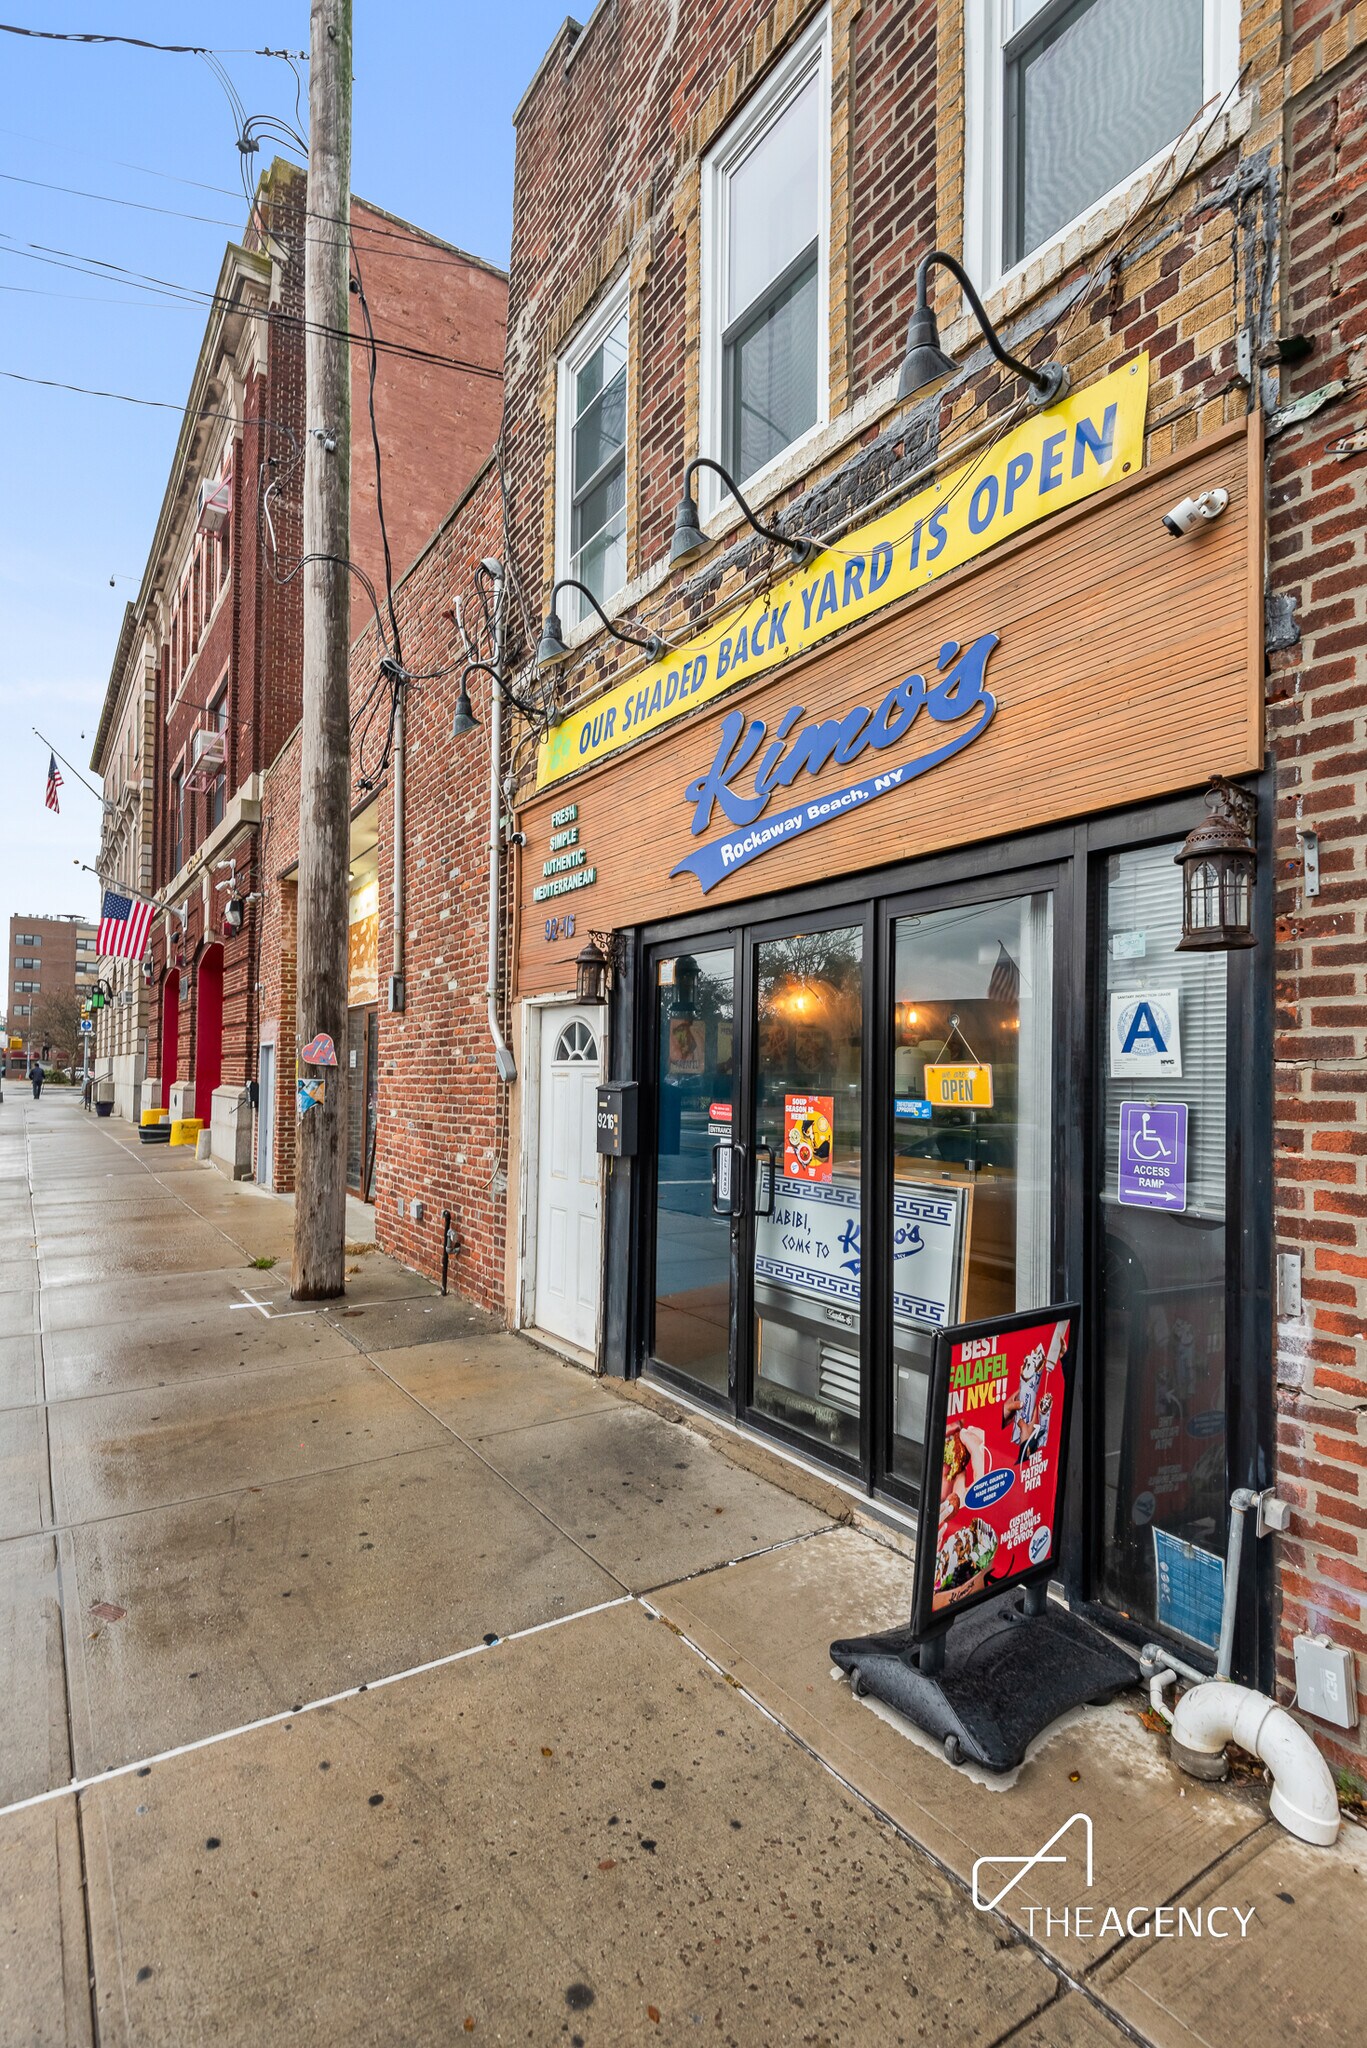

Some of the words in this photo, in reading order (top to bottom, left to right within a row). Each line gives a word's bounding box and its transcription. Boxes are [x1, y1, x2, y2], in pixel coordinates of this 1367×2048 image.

[579, 707, 616, 754] OUR
[622, 654, 708, 732] SHADED
[716, 601, 791, 680] BACK
[801, 541, 893, 630] YARD
[909, 505, 948, 571] IS
[968, 402, 1117, 535] OPEN
[685, 633, 1000, 836] Kimo's
[551, 804, 578, 828] FRESH
[720, 814, 802, 867] Rockaway
[807, 789, 869, 820] Beach,
[874, 768, 903, 791] NY
[550, 828, 579, 851] SIMPLE
[542, 849, 586, 877] AUTHENTIC
[533, 867, 597, 902] MEDITERRANEAN
[544, 914, 576, 941] 92-16
[1121, 1002, 1168, 1053] A
[792, 1097, 807, 1105] SOUP
[941, 1079, 973, 1102] OPEN
[597, 1112, 614, 1130] 9216
[785, 1105, 807, 1113] SEASON
[1133, 1164, 1170, 1177] ACCESS
[1138, 1177, 1165, 1189] RAMP
[781, 1233, 811, 1255] COME
[815, 1240, 830, 1259] TO
[961, 1335, 999, 1362] BEST
[947, 1388, 965, 1417] IN
[966, 1377, 1008, 1411] NYC!!
[1029, 1449, 1043, 1467] THE
[1020, 1458, 1048, 1483] FATBOY
[1024, 1475, 1041, 1493] PITA
[1000, 1524, 1019, 1544] MADE
[1019, 1512, 1041, 1533] BOWLS
[1009, 1507, 1034, 1529] CUSTOM
[1006, 1541, 1013, 1550] &
[1013, 1527, 1034, 1546] GYROS
